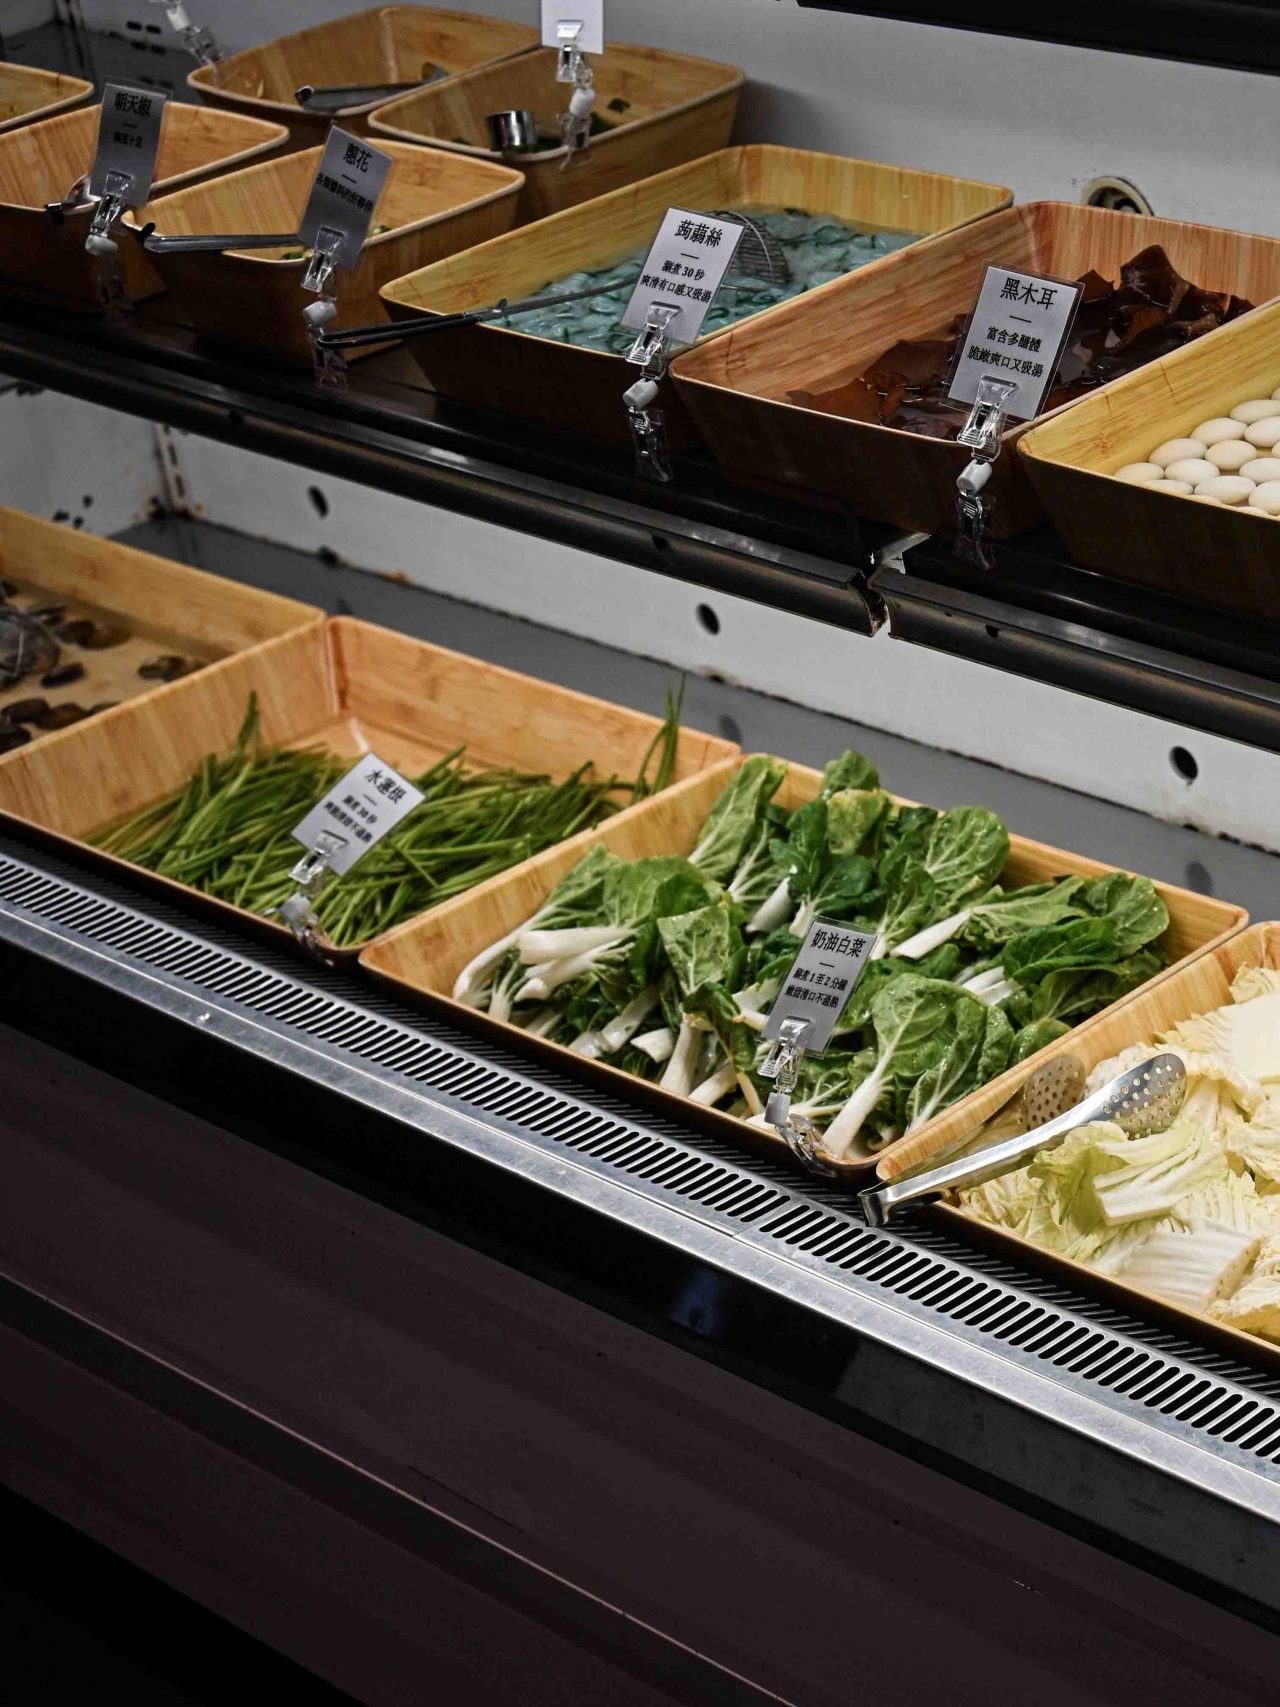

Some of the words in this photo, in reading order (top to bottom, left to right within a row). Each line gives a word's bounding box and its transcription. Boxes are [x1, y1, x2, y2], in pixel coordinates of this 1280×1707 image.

[114, 91, 152, 117] 朝天椒
[675, 220, 723, 248] 蒟蒻絲
[682, 266, 694, 278] 30
[694, 269, 705, 281] 秒
[640, 274, 712, 303] 爽滑有口感又吸湯
[1000, 277, 1057, 310] 黑木耳
[986, 327, 1041, 353] 富含多醣體
[967, 346, 1044, 378] 脆嫩爽口又吸湯
[810, 929, 866, 957] 奶油白菜
[815, 974, 826, 985] 至
[829, 977, 848, 991] 分鐘
